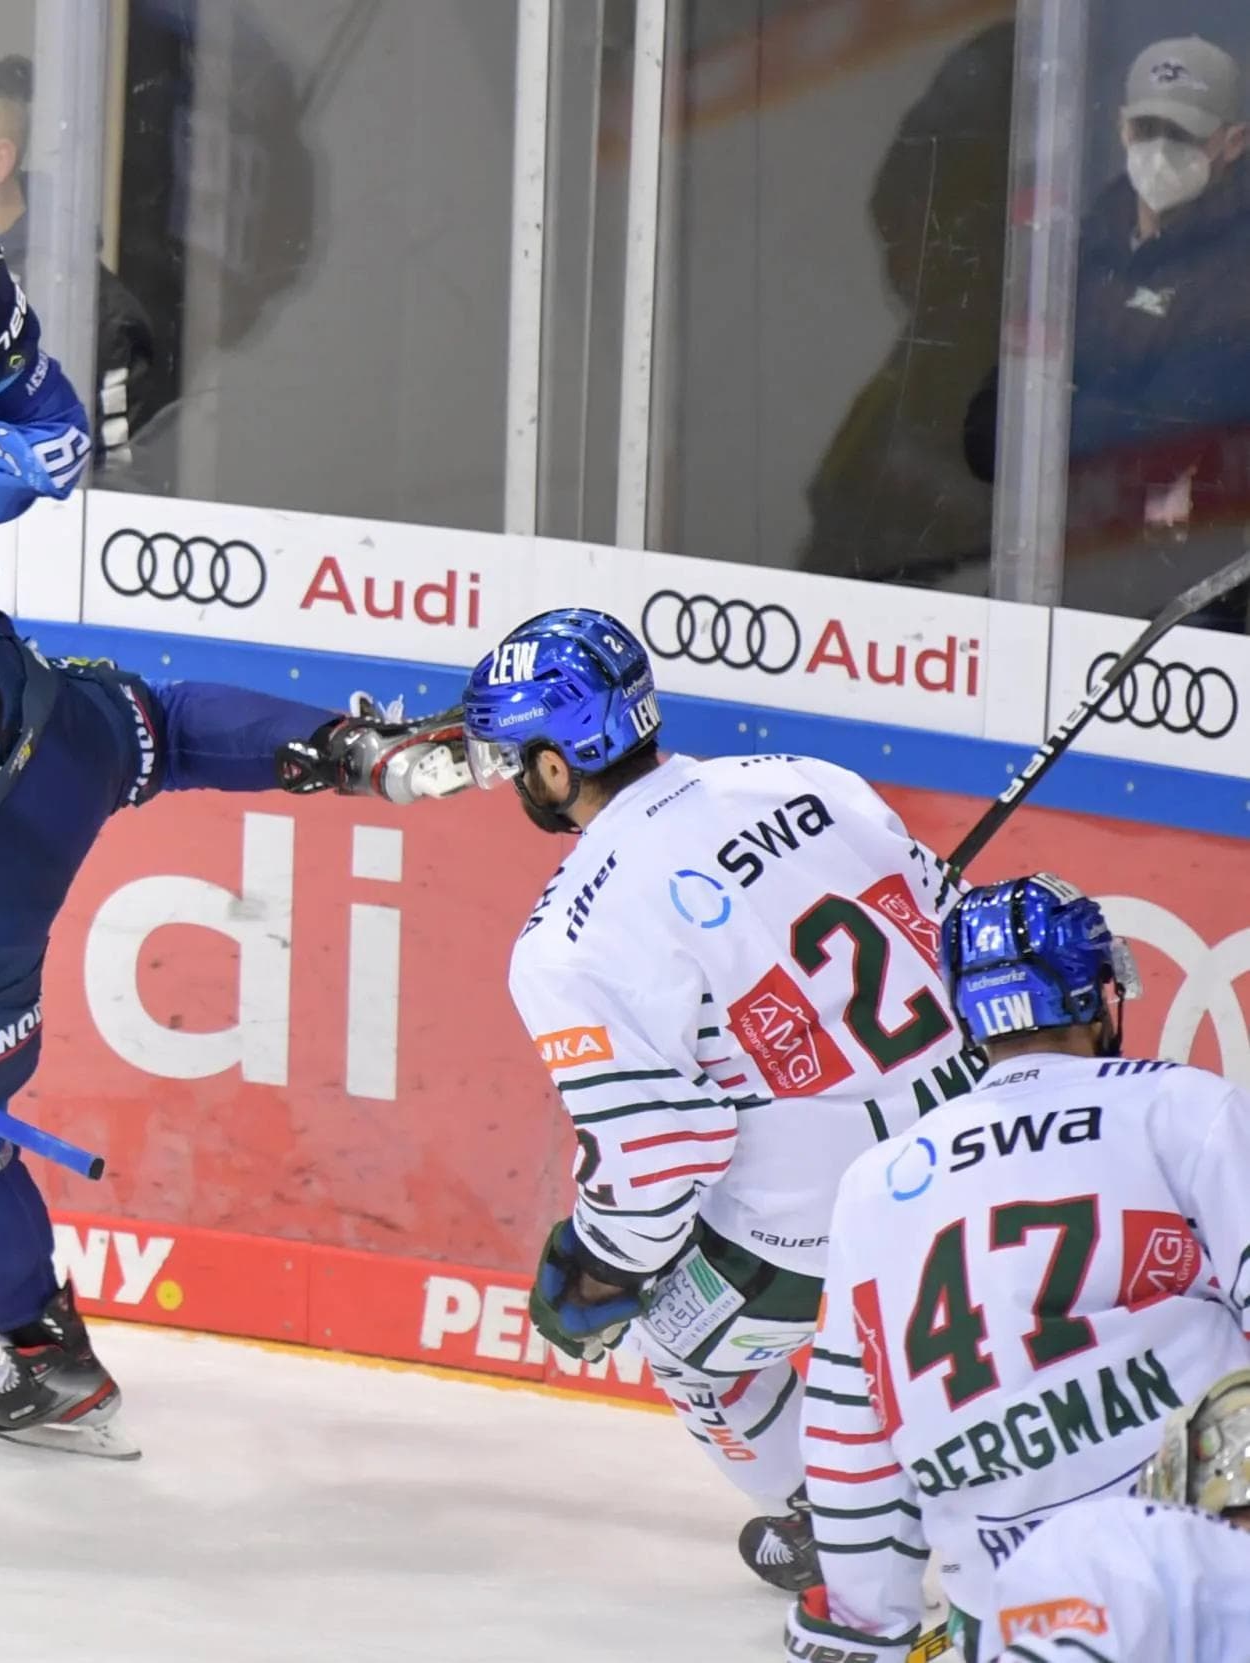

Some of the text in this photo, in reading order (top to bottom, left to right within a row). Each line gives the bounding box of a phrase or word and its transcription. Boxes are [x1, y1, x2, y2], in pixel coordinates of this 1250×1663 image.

[299, 555, 481, 630] Audi
[489, 641, 539, 686] LEW
[805, 618, 980, 698] Audi
[499, 705, 545, 728] Lechwerke
[717, 792, 835, 888] swa
[566, 850, 618, 943] ritter
[790, 892, 953, 1075] 2
[976, 990, 1036, 1037] LEW
[749, 1004, 814, 1085] AMG
[949, 1106, 1103, 1173] swa
[904, 1193, 1100, 1412] 47
[911, 1349, 1183, 1496] BERGMAN
